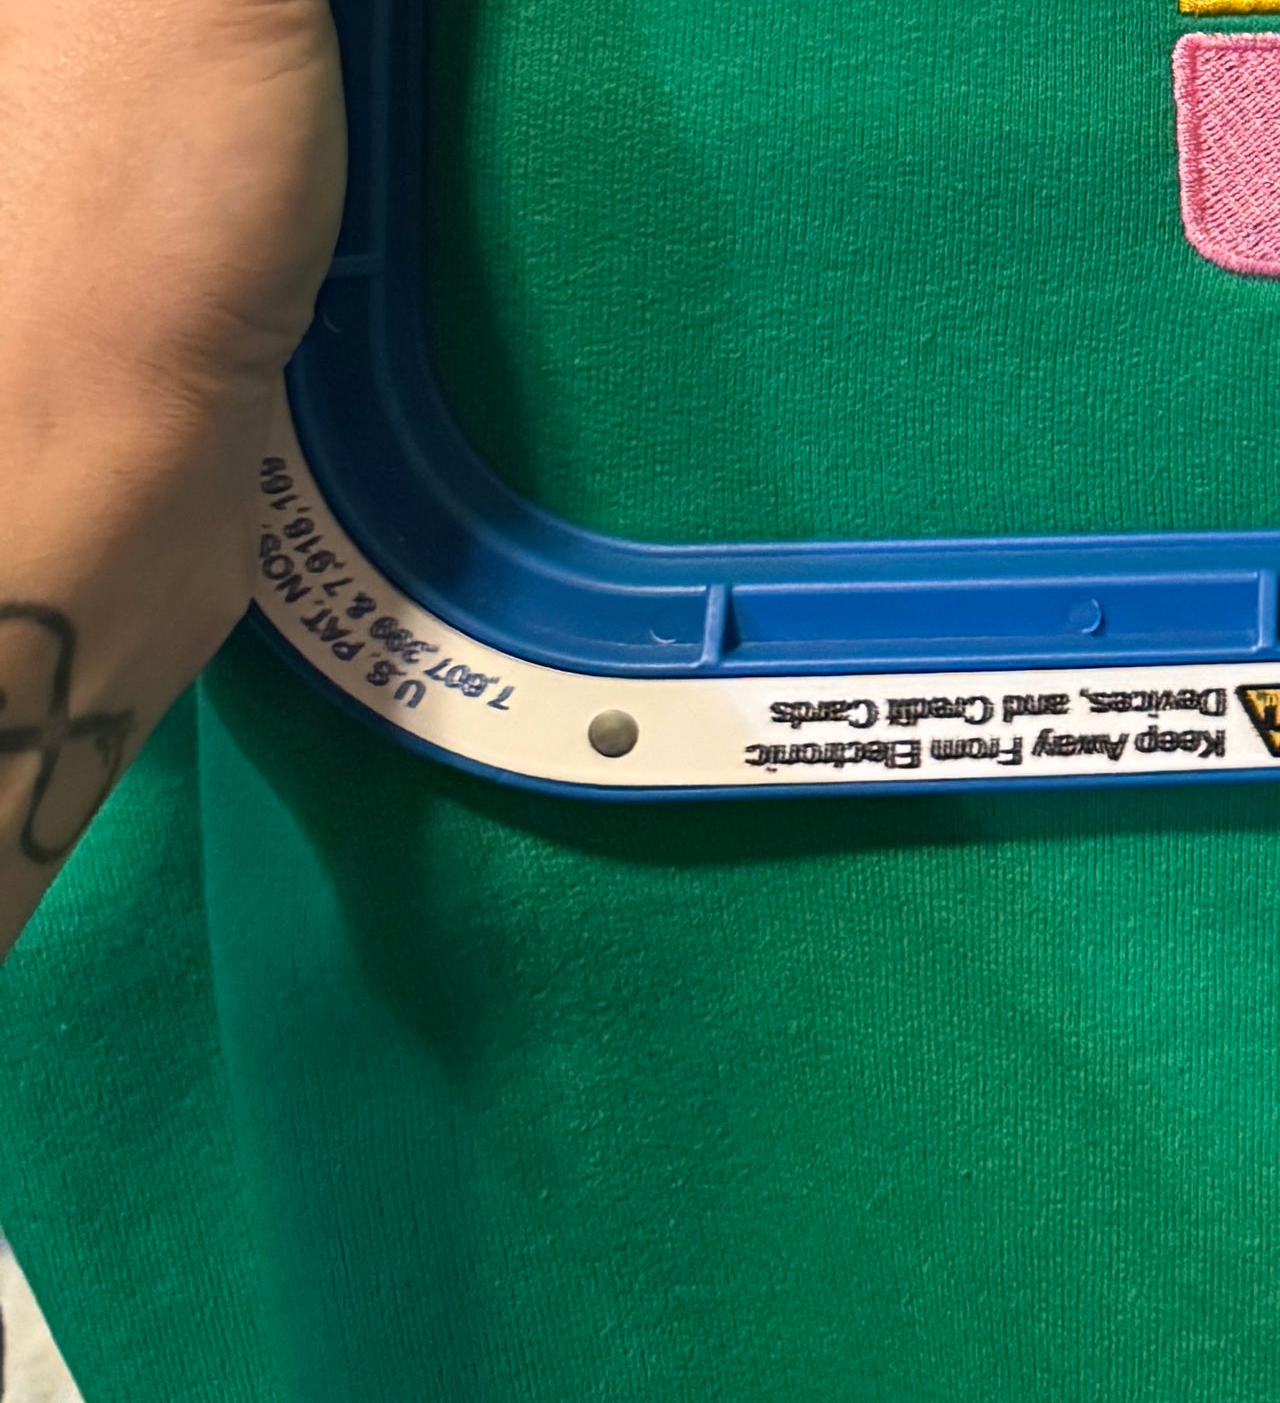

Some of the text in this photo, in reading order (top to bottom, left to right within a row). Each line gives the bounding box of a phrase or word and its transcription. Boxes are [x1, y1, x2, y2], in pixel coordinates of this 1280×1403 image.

[345, 591, 378, 619] &
[300, 599, 366, 661] PAT.
[768, 687, 1228, 730] Devices, and Credit Cards
[743, 724, 1227, 773] Keep Away From Electronic
